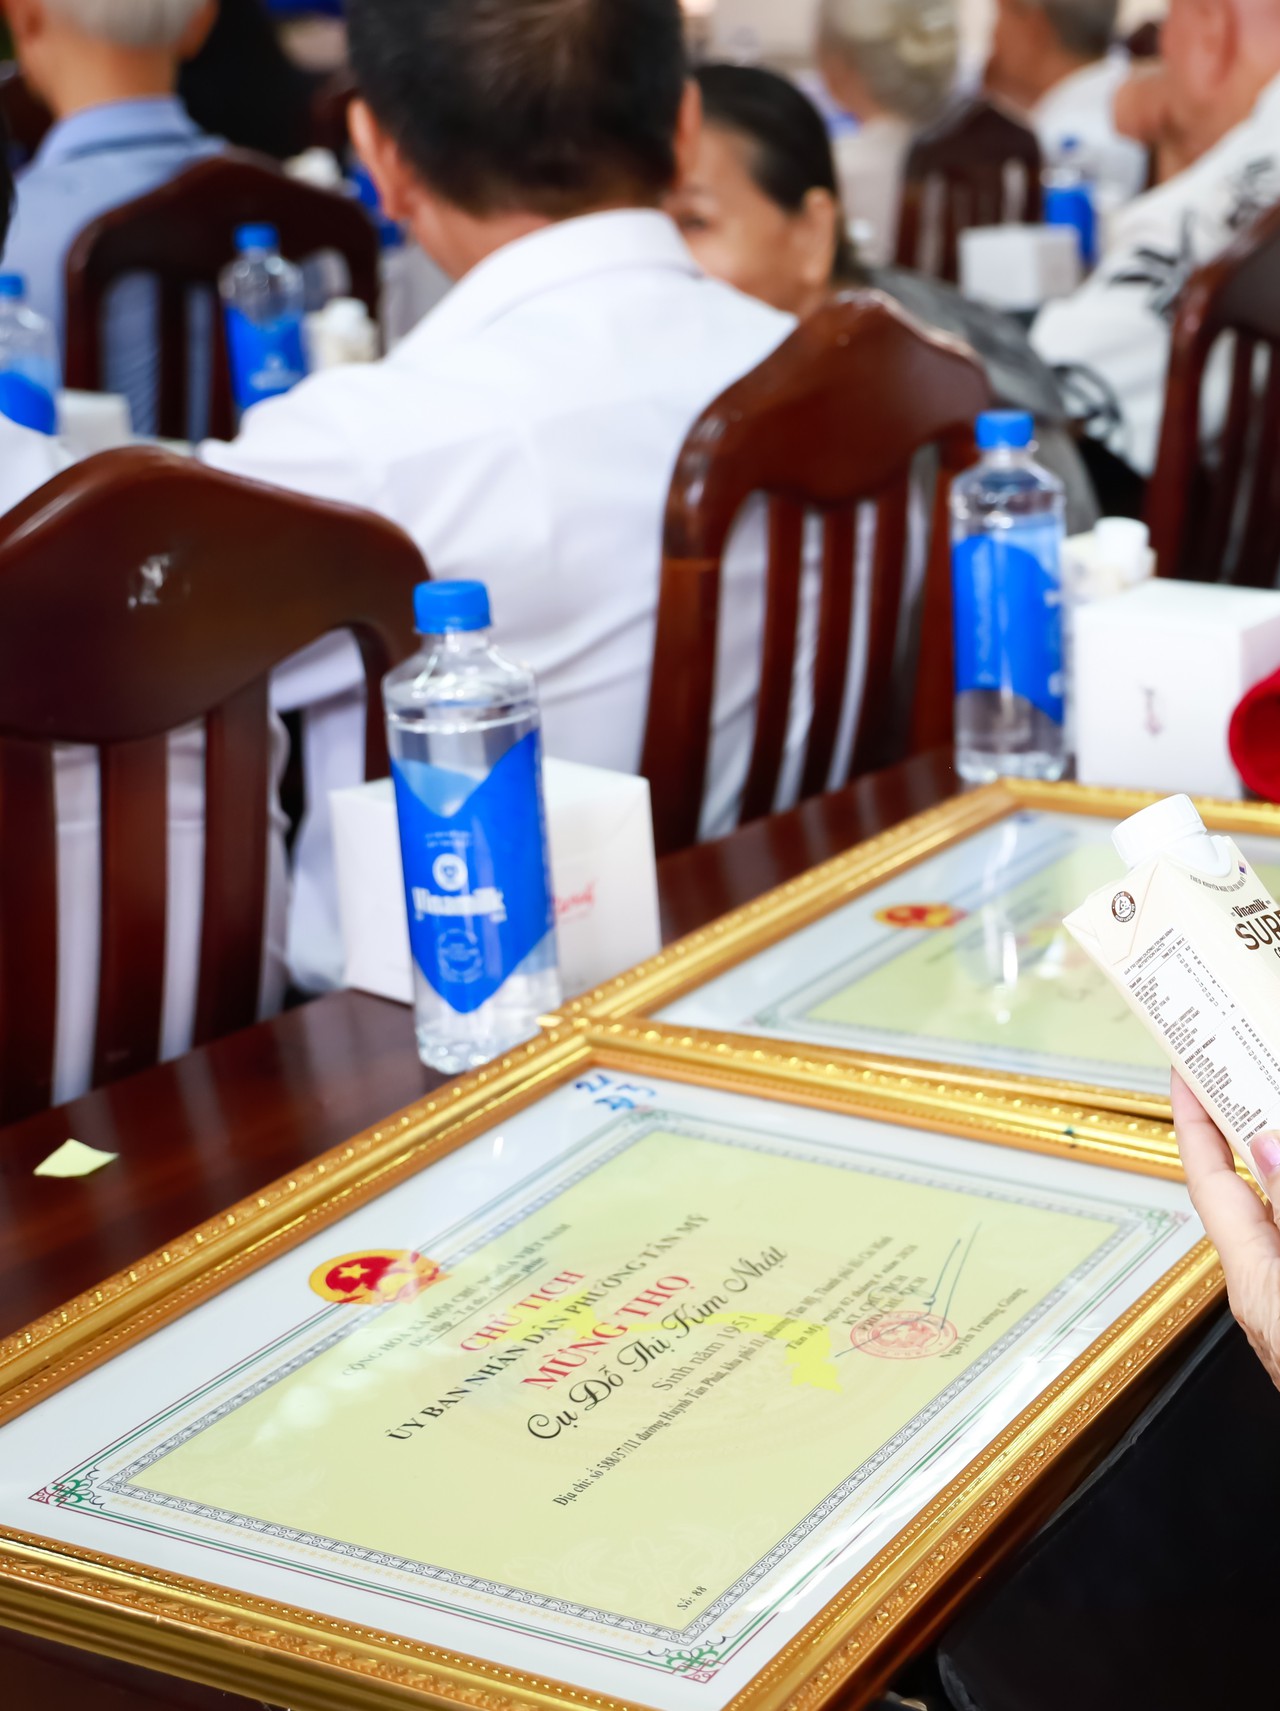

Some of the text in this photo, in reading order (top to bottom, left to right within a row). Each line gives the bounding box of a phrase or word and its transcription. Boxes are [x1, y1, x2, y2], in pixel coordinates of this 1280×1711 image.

[1232, 899, 1268, 918] Vinamilk
[386, 1417, 426, 1440] ỦY
[420, 1386, 472, 1418] BAN
[464, 1346, 528, 1386] NHÂN
[522, 1317, 569, 1344] DÂN
[563, 1262, 646, 1314] PHƯỜNG
[638, 1235, 681, 1260] TÂN
[460, 1270, 586, 1351] CHỦ TỊCH
[521, 1275, 695, 1390] MỪNG THỌ
[527, 1246, 788, 1439] Cụ Đỗ Thị Kim Nhật
[784, 1336, 807, 1349] Tân
[651, 1315, 757, 1390] Sinh năm 1951
[552, 1491, 577, 1505] Địa
[572, 1478, 594, 1492] chỉ:
[585, 1467, 603, 1479] số
[596, 1439, 641, 1470] 588/37/11
[635, 1419, 671, 1440] đường
[658, 1398, 693, 1420] Huỳnh
[683, 1386, 708, 1398] Tấn
[719, 1359, 743, 1371] khu
[676, 1585, 707, 1610] Số: 88
